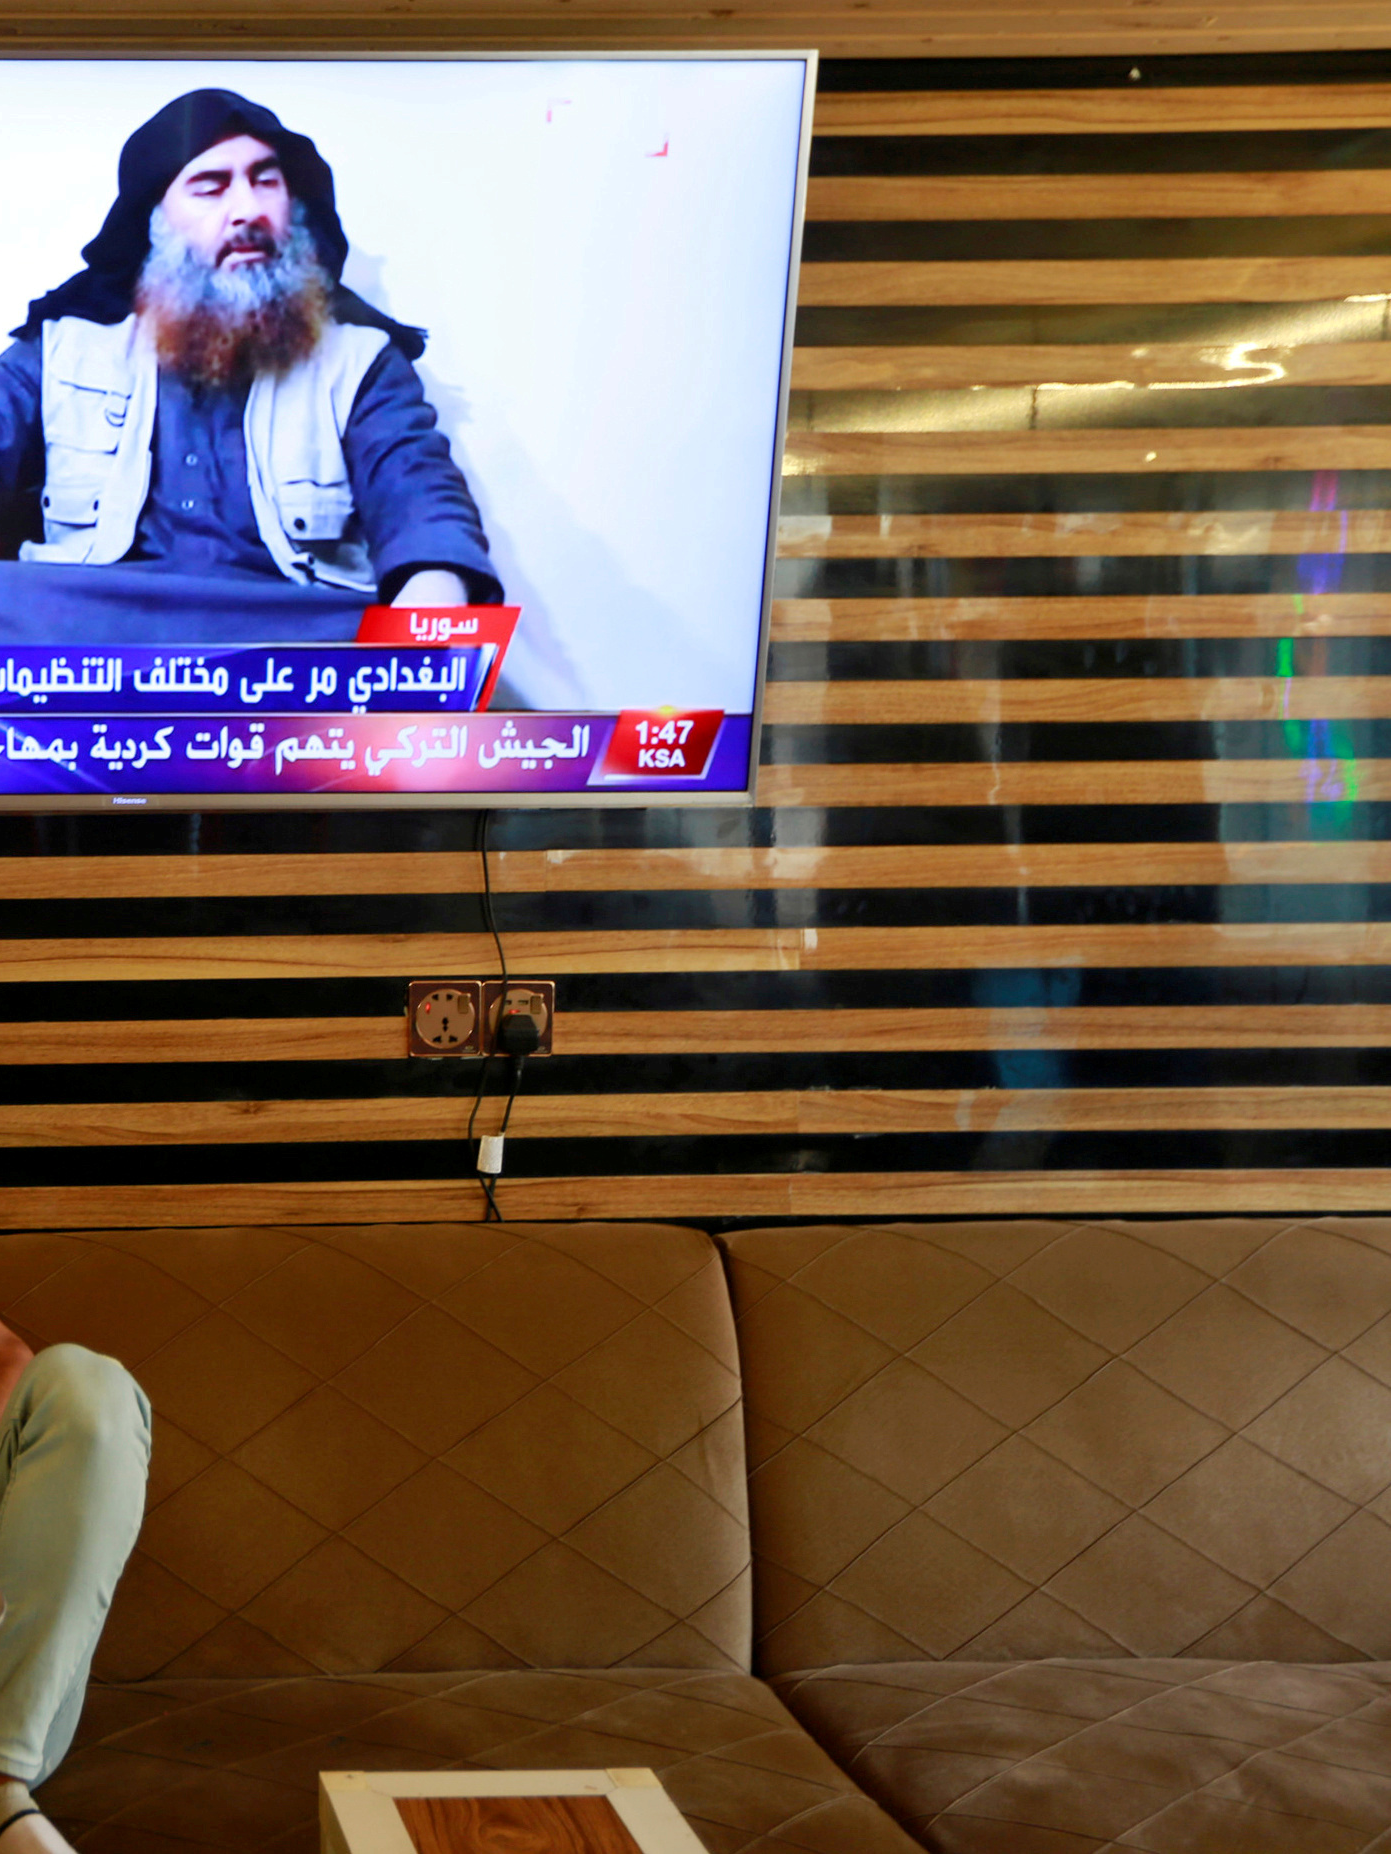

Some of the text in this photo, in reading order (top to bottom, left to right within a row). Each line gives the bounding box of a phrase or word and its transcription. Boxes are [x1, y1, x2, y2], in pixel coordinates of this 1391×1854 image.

[409, 612, 479, 641] سوريا
[133, 656, 229, 696] مختلف
[239, 657, 295, 704] على
[304, 666, 338, 703] مر
[348, 655, 467, 714] البغدادي
[89, 723, 175, 770] كردية
[185, 722, 265, 769] قوات
[274, 727, 356, 776] يتهم
[364, 724, 468, 777] التركي
[477, 720, 591, 770] الجيش
[635, 719, 695, 746] 1:47
[637, 748, 686, 769] KSA
[112, 797, 148, 805] Hisense
